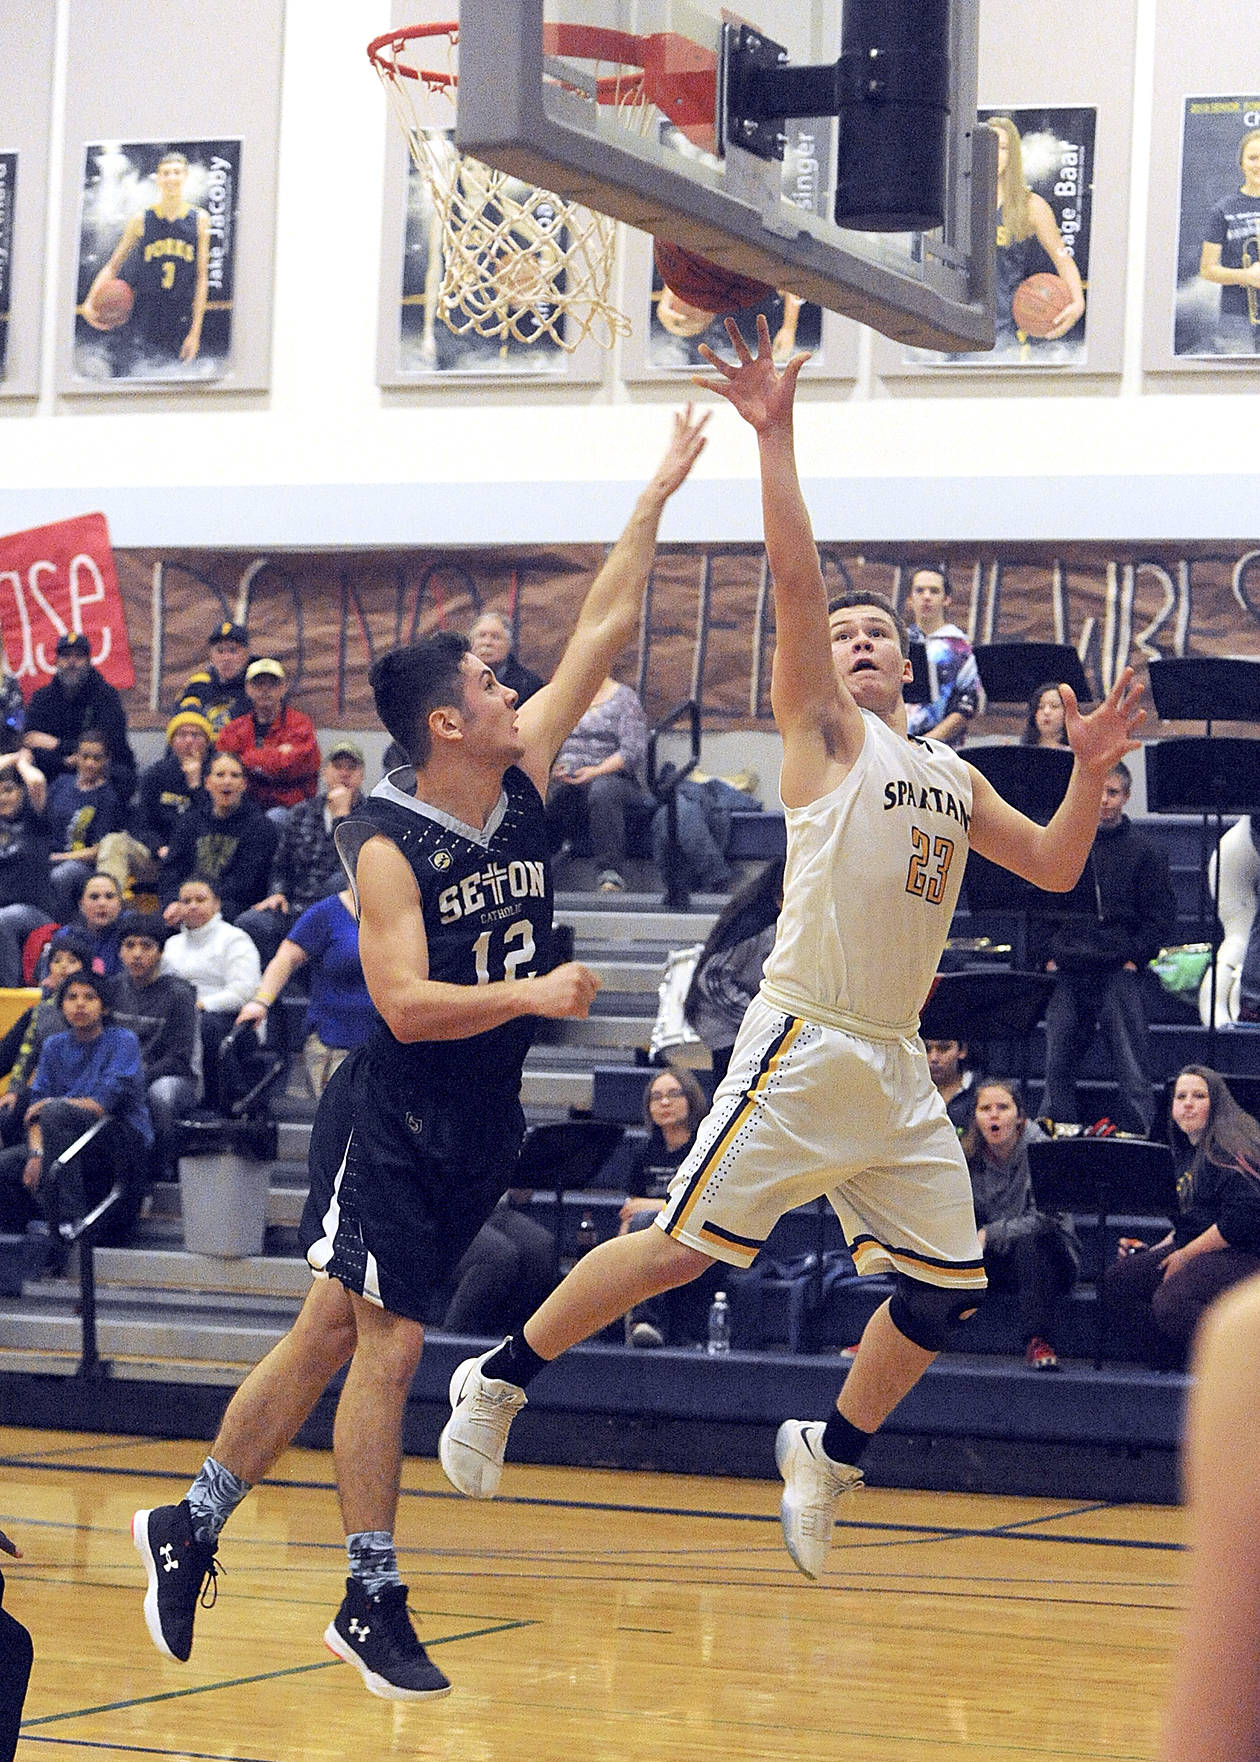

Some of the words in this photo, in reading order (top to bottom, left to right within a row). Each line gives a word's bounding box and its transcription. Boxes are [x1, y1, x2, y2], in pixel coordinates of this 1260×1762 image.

[206, 156, 232, 239] Jacoby
[1053, 140, 1079, 197] Baar
[1056, 208, 1080, 257] Sage
[208, 246, 225, 289] Jake
[438, 860, 545, 925] SETON
[905, 825, 954, 905] 23
[471, 918, 537, 985] 12
